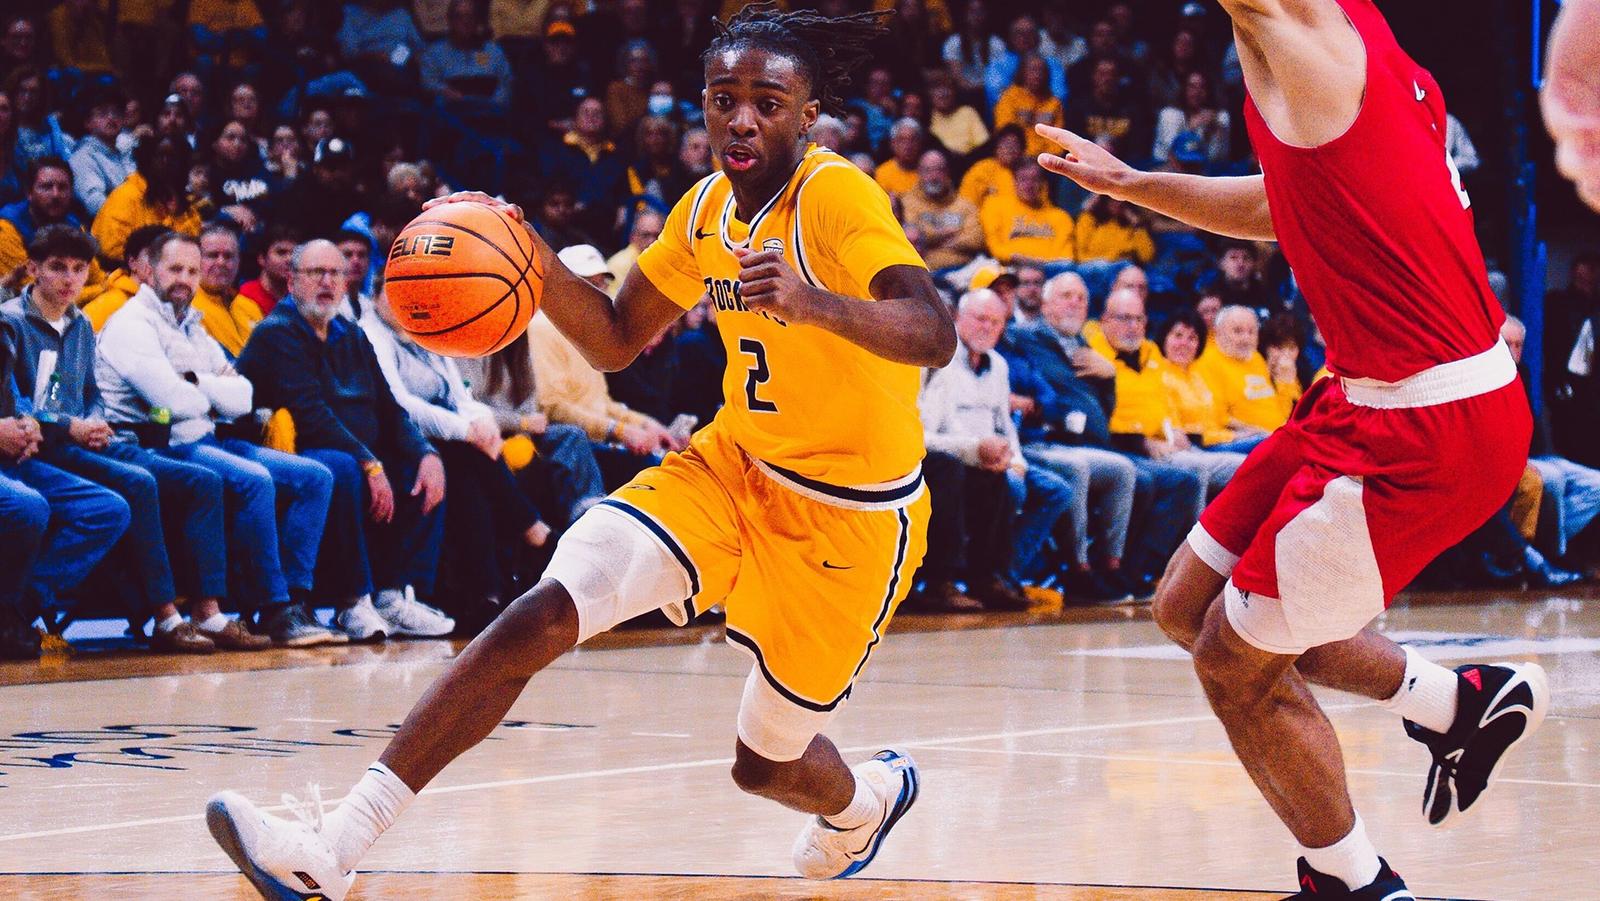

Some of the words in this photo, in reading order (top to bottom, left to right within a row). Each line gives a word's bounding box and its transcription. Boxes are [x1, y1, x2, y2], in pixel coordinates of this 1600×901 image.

[389, 236, 455, 260] ELITE
[703, 276, 788, 328] ROCK
[739, 338, 779, 413] 2
